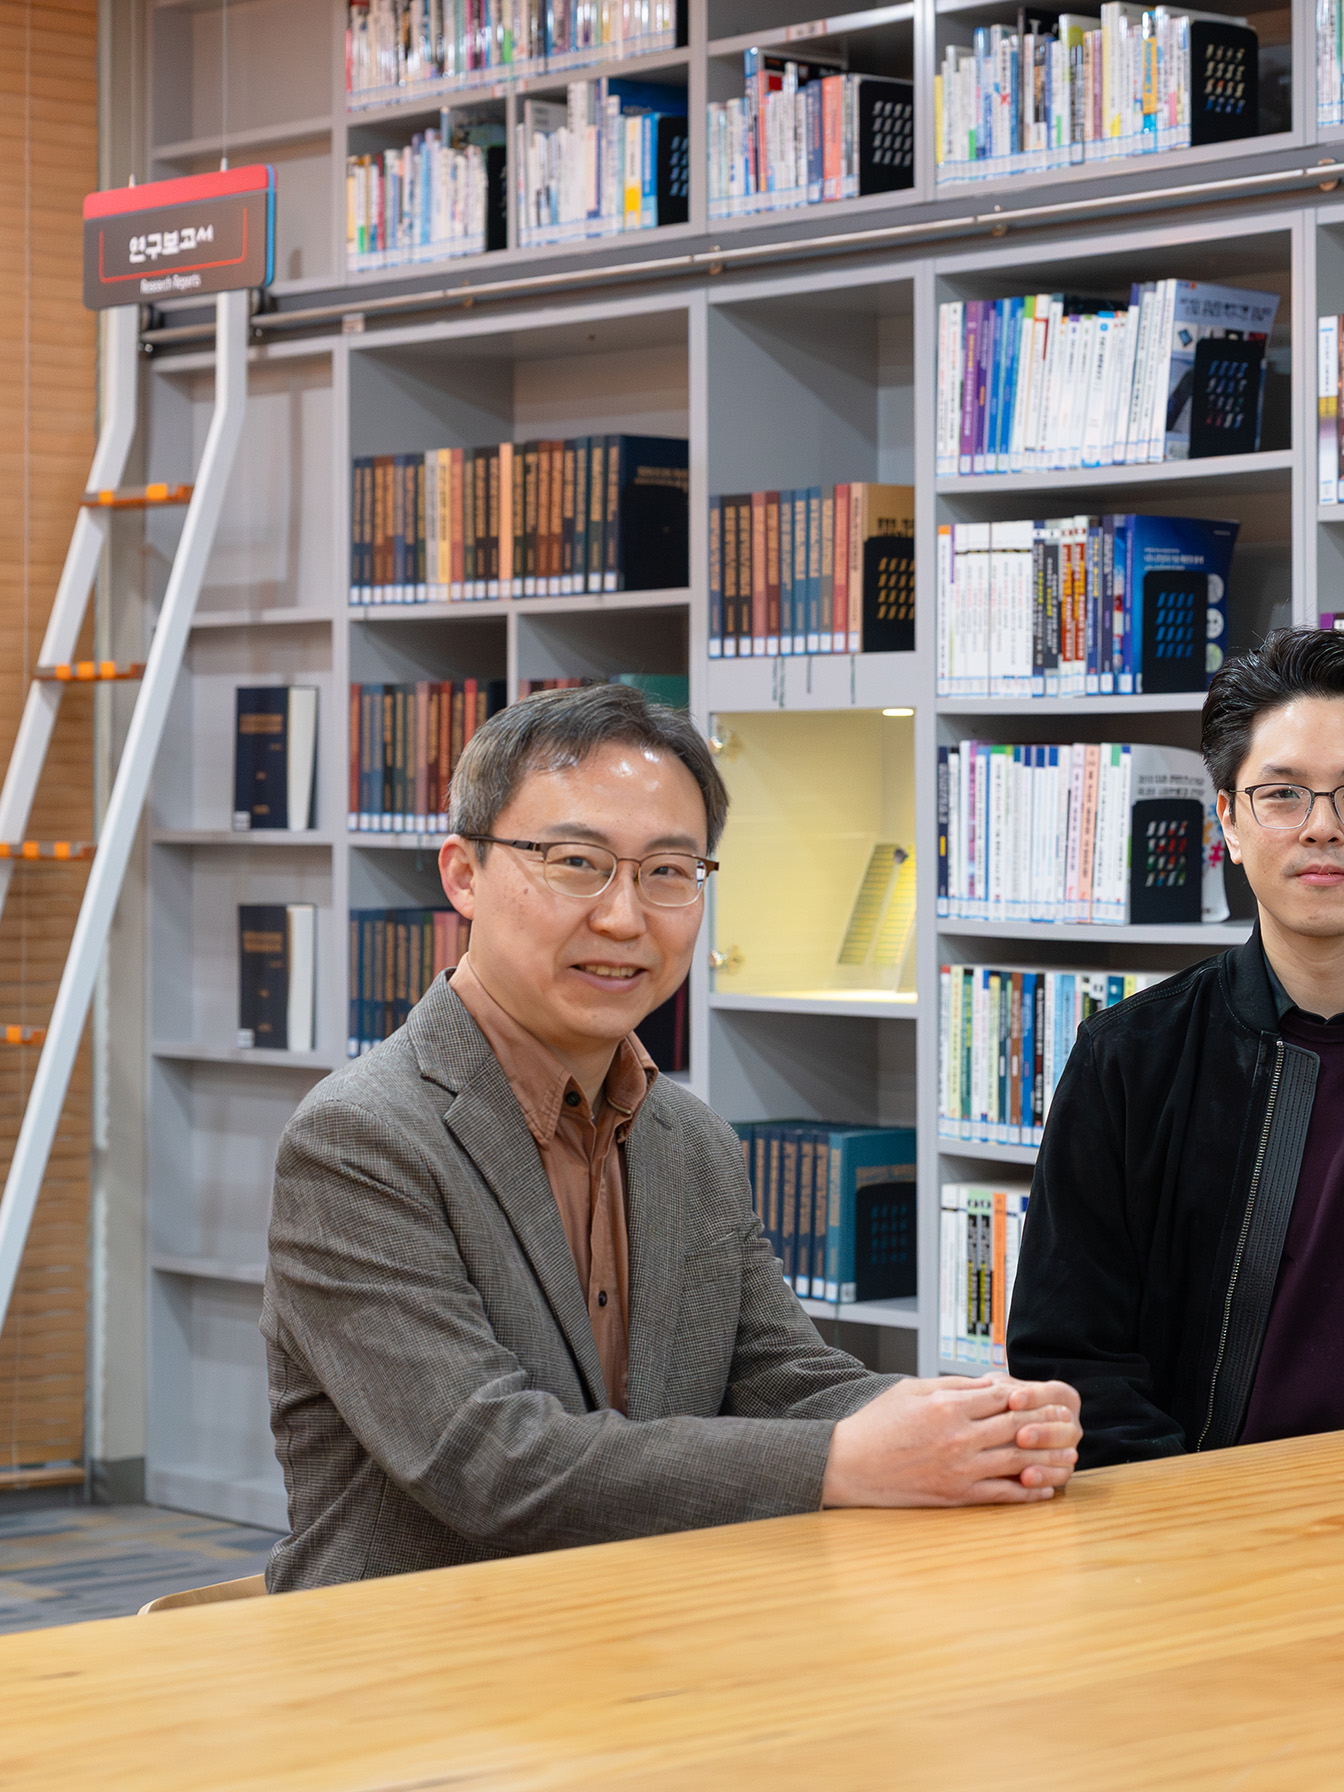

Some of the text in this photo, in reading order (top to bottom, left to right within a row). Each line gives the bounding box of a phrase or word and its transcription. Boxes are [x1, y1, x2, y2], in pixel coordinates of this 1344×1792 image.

[129, 224, 214, 264] 연구보고서
[140, 273, 201, 294] Research Reports
